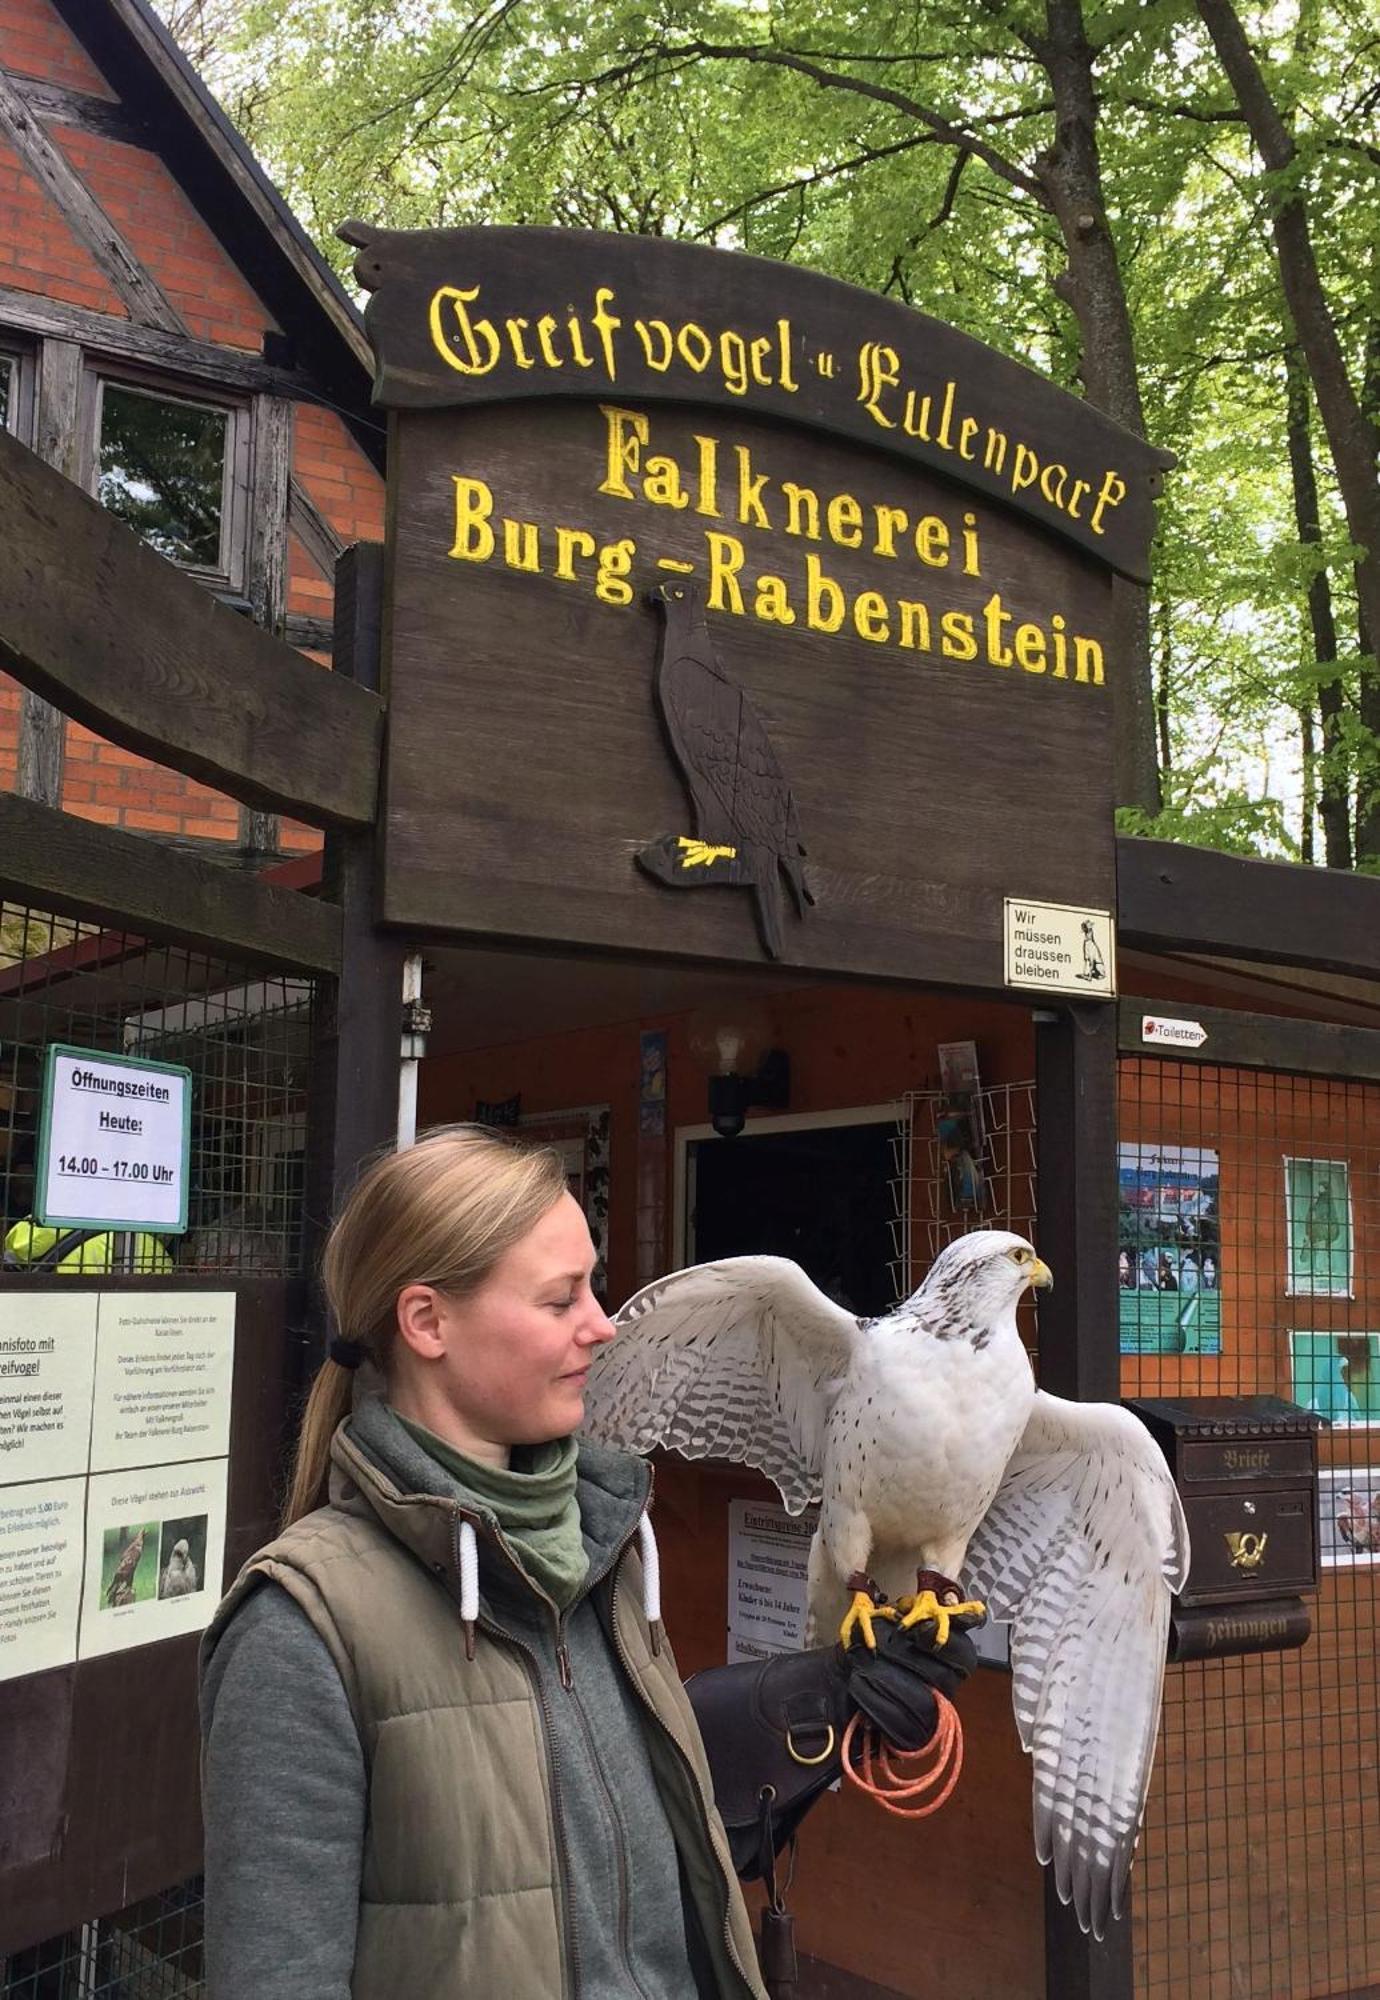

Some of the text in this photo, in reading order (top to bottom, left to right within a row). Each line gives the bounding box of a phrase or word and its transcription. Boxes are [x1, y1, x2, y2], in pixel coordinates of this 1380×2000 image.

[857, 341, 1126, 534] Eulenpark
[597, 405, 981, 577] Falknerei
[1014, 909, 1036, 925] Wir
[1014, 928, 1061, 945] müssen
[1014, 944, 1072, 964] draussen
[1015, 961, 1060, 979] bleiben
[1158, 1024, 1201, 1041] Toiletten
[71, 1067, 169, 1100] Öffnungszeiten
[99, 1111, 142, 1132] Heute:
[59, 1155, 98, 1174] 14.00
[113, 1161, 149, 1179] 17.00
[152, 1165, 174, 1182] Uhr
[38, 1336, 54, 1350] mit
[1223, 1449, 1270, 1470] Briefe
[1206, 1616, 1288, 1648] Zeitungen
